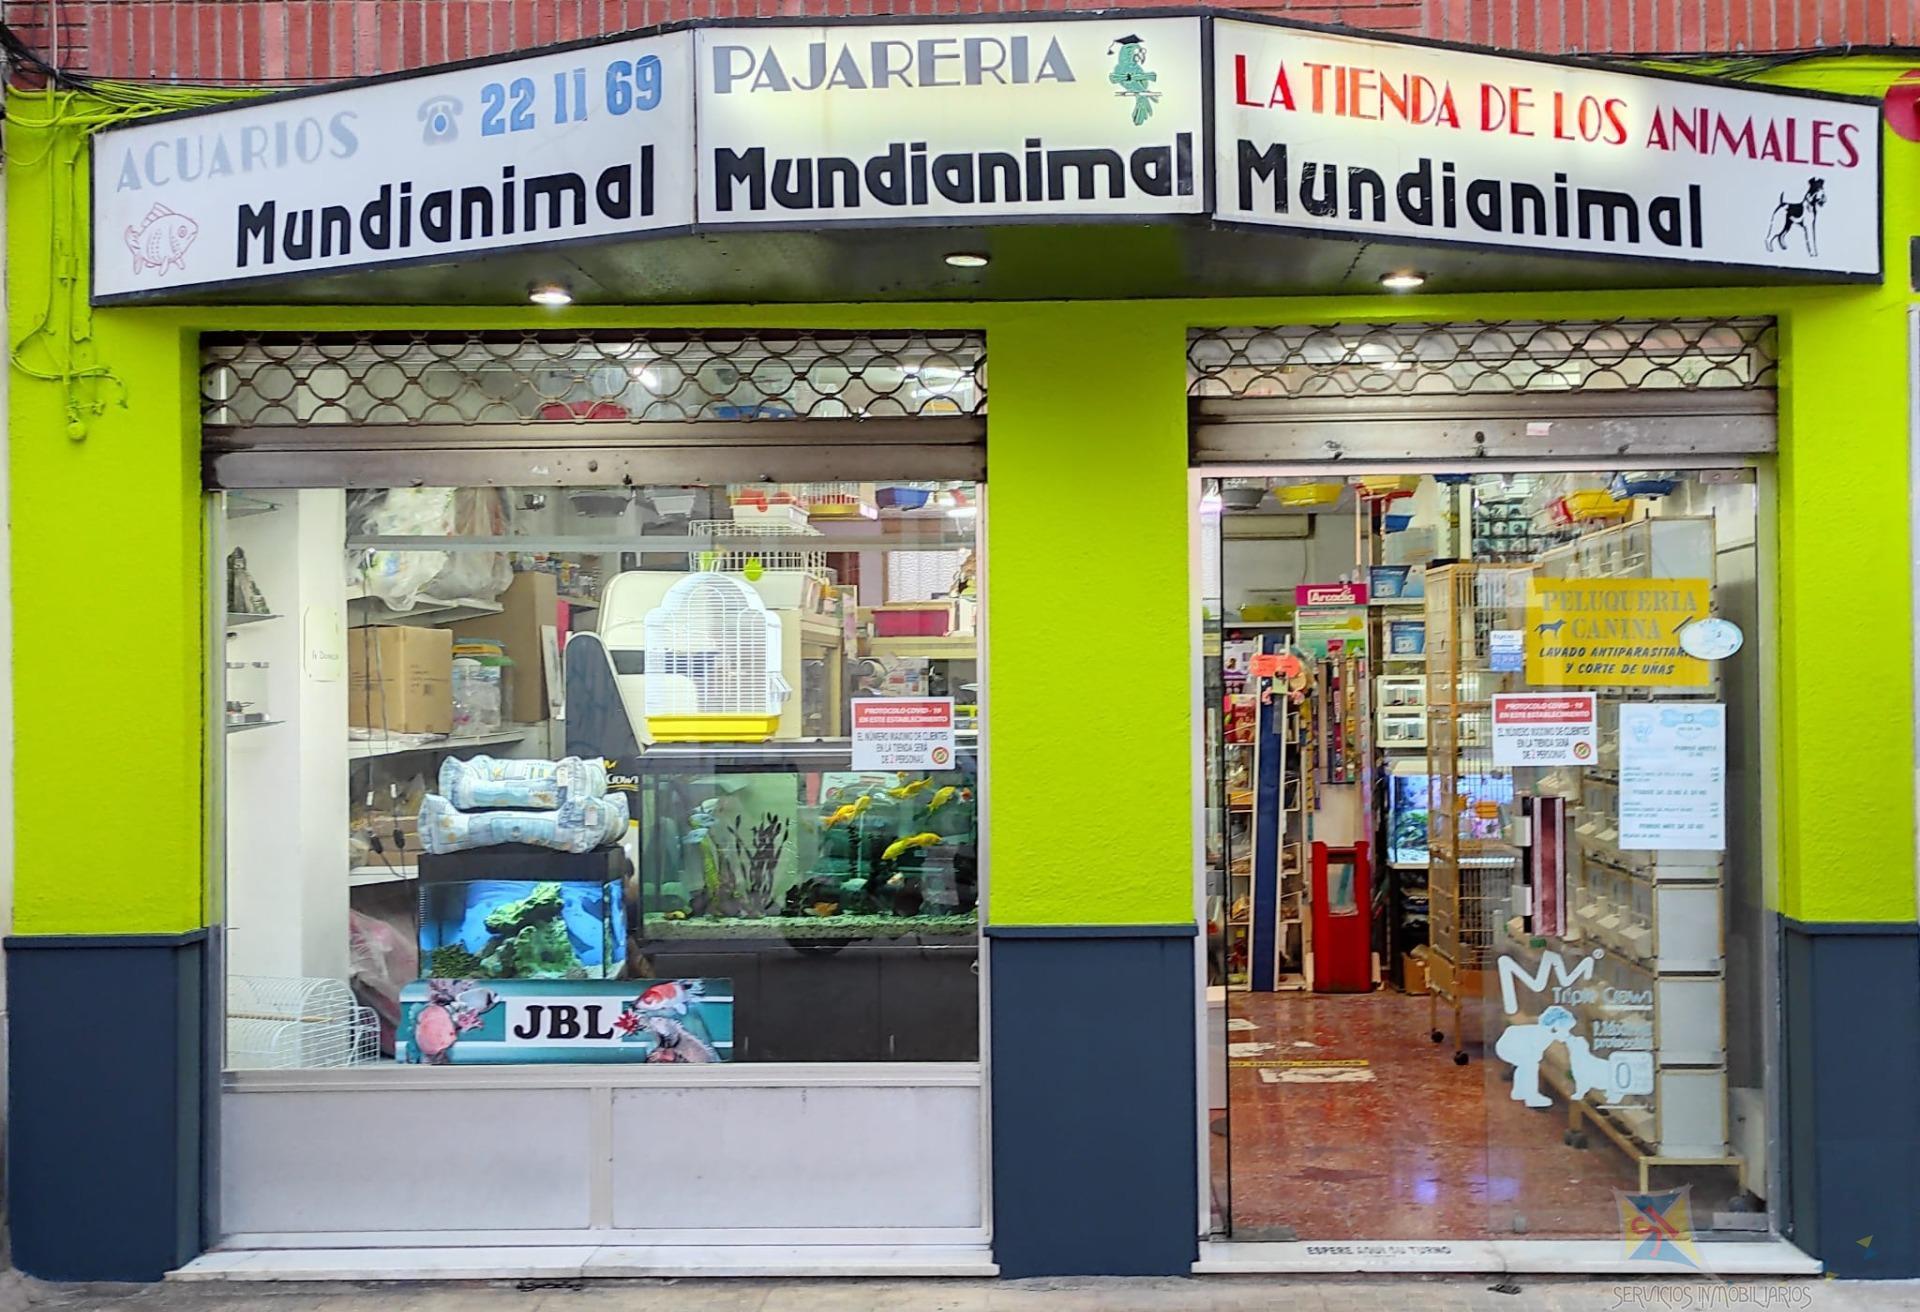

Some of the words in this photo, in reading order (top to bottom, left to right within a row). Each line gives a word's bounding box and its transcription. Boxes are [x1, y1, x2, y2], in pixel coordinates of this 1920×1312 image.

[713, 35, 1076, 94] PAJARERIA
[481, 77, 535, 137] 22
[554, 67, 588, 125] 11
[606, 54, 662, 116] 69
[1235, 54, 1297, 111] LA
[1304, 62, 1460, 130] TIENDA
[1480, 83, 1535, 137] DE
[1554, 92, 1628, 145] LOS
[1646, 104, 1860, 169] ANIMALES
[116, 110, 359, 193] ACUARIOS
[714, 131, 1194, 211] Mundianimal
[237, 145, 654, 268] Mundianimal
[1238, 139, 1702, 248] Mundianimal
[1310, 587, 1355, 602] Arcadia
[1543, 590, 1697, 611] PELUQUERIA
[1539, 647, 1585, 657] LAVADO
[1570, 618, 1662, 640] CANINA
[1578, 664, 1616, 674] CORTE
[1621, 664, 1636, 674] DE
[1603, 986, 1653, 1004] Crown
[513, 1005, 614, 1039] JBL
